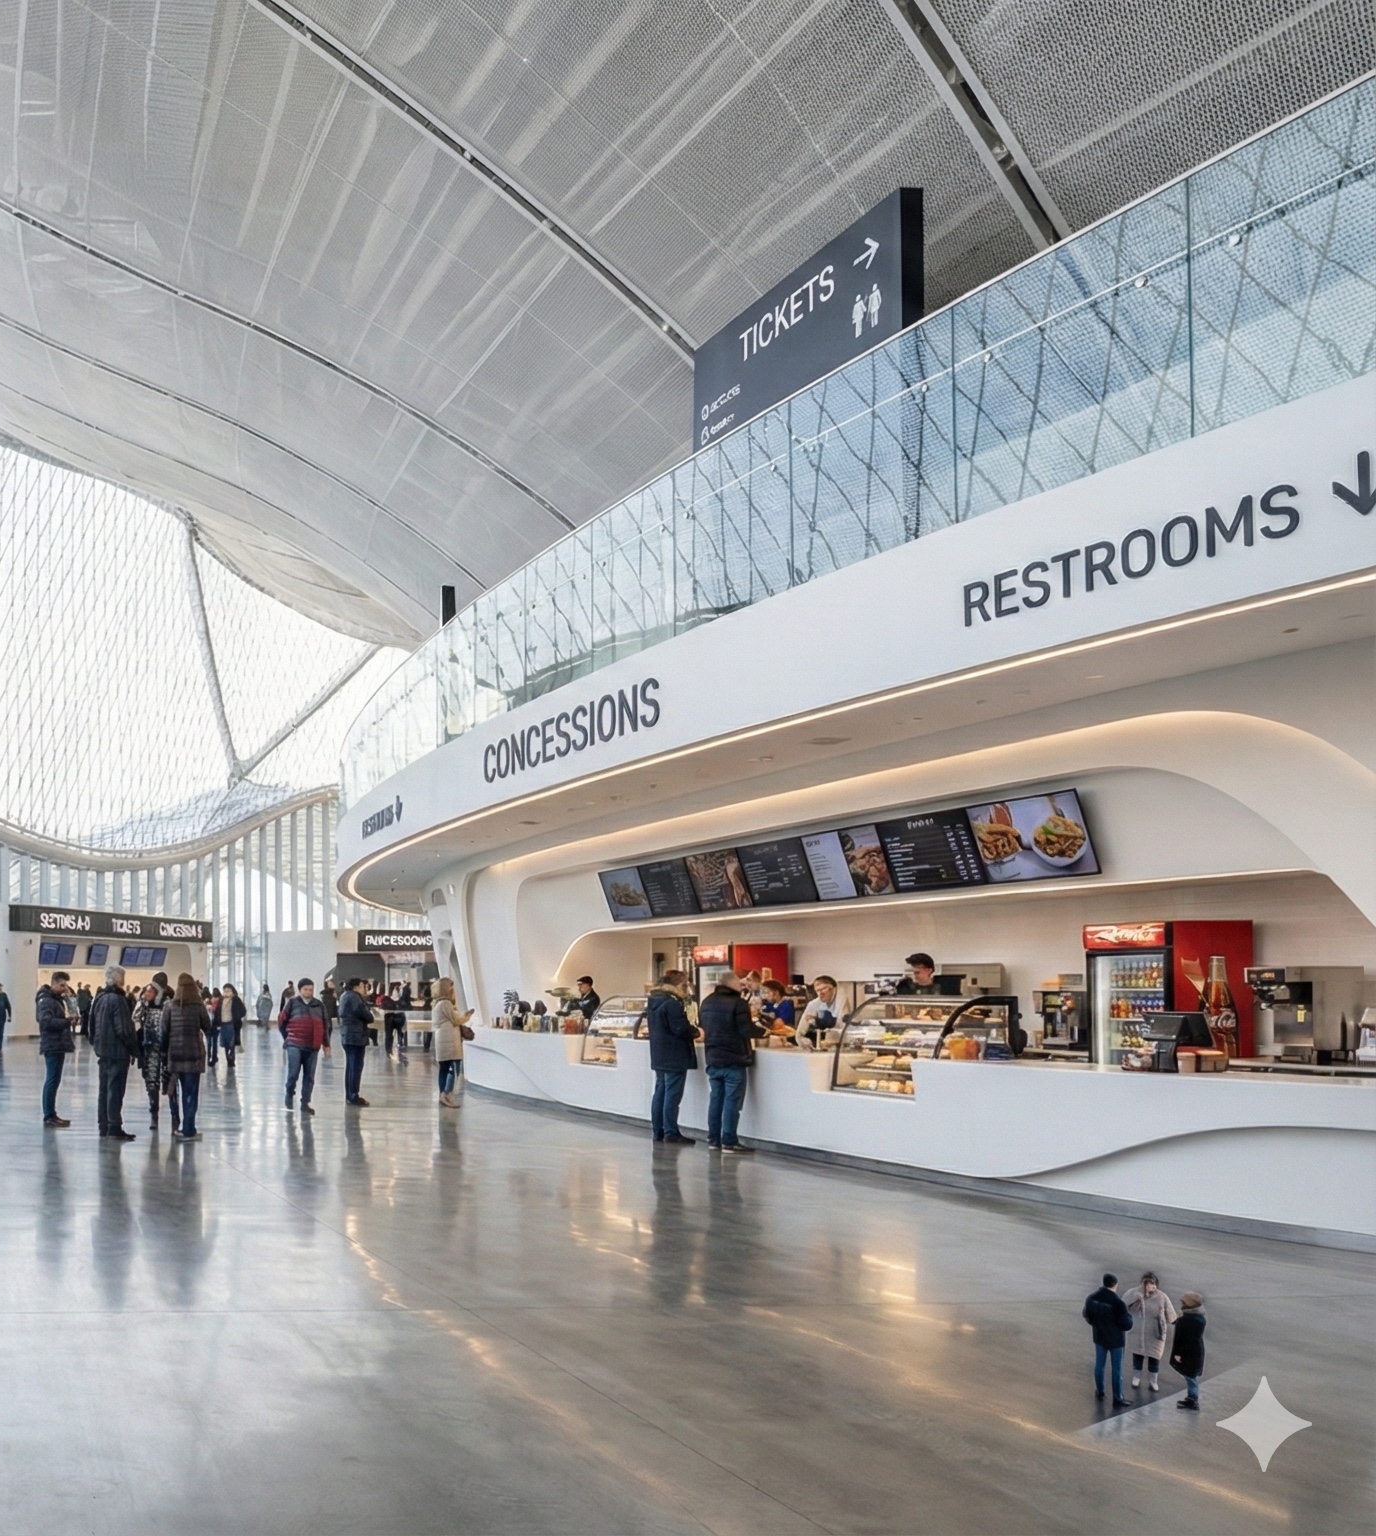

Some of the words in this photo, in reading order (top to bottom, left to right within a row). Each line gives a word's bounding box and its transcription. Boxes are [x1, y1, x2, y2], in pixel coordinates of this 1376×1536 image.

[738, 264, 835, 362] TICKETS
[963, 484, 1300, 627] RESTROOMS
[483, 677, 660, 783] CONCESSIONS
